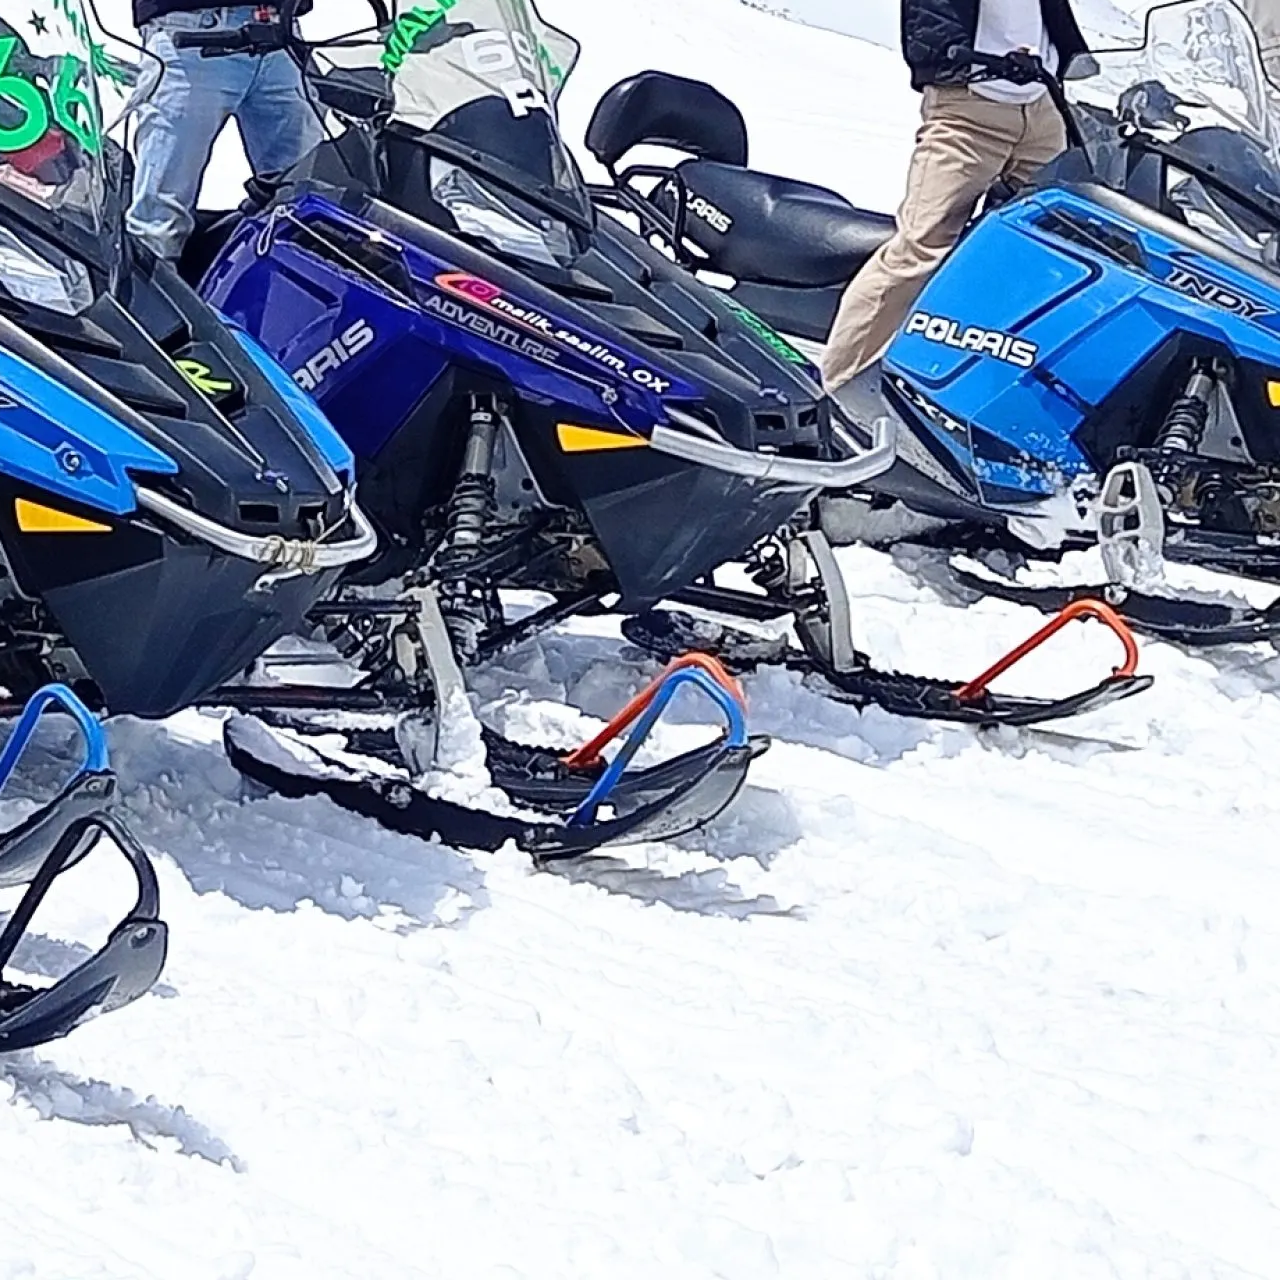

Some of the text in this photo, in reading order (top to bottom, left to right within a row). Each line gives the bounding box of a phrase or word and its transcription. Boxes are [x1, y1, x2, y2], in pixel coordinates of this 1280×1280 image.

[1168, 267, 1276, 319] INDY
[291, 318, 375, 392] ARIS
[424, 294, 560, 362] ADVENTURE
[905, 312, 1039, 368] POLARIS
[895, 379, 967, 432] LXT
